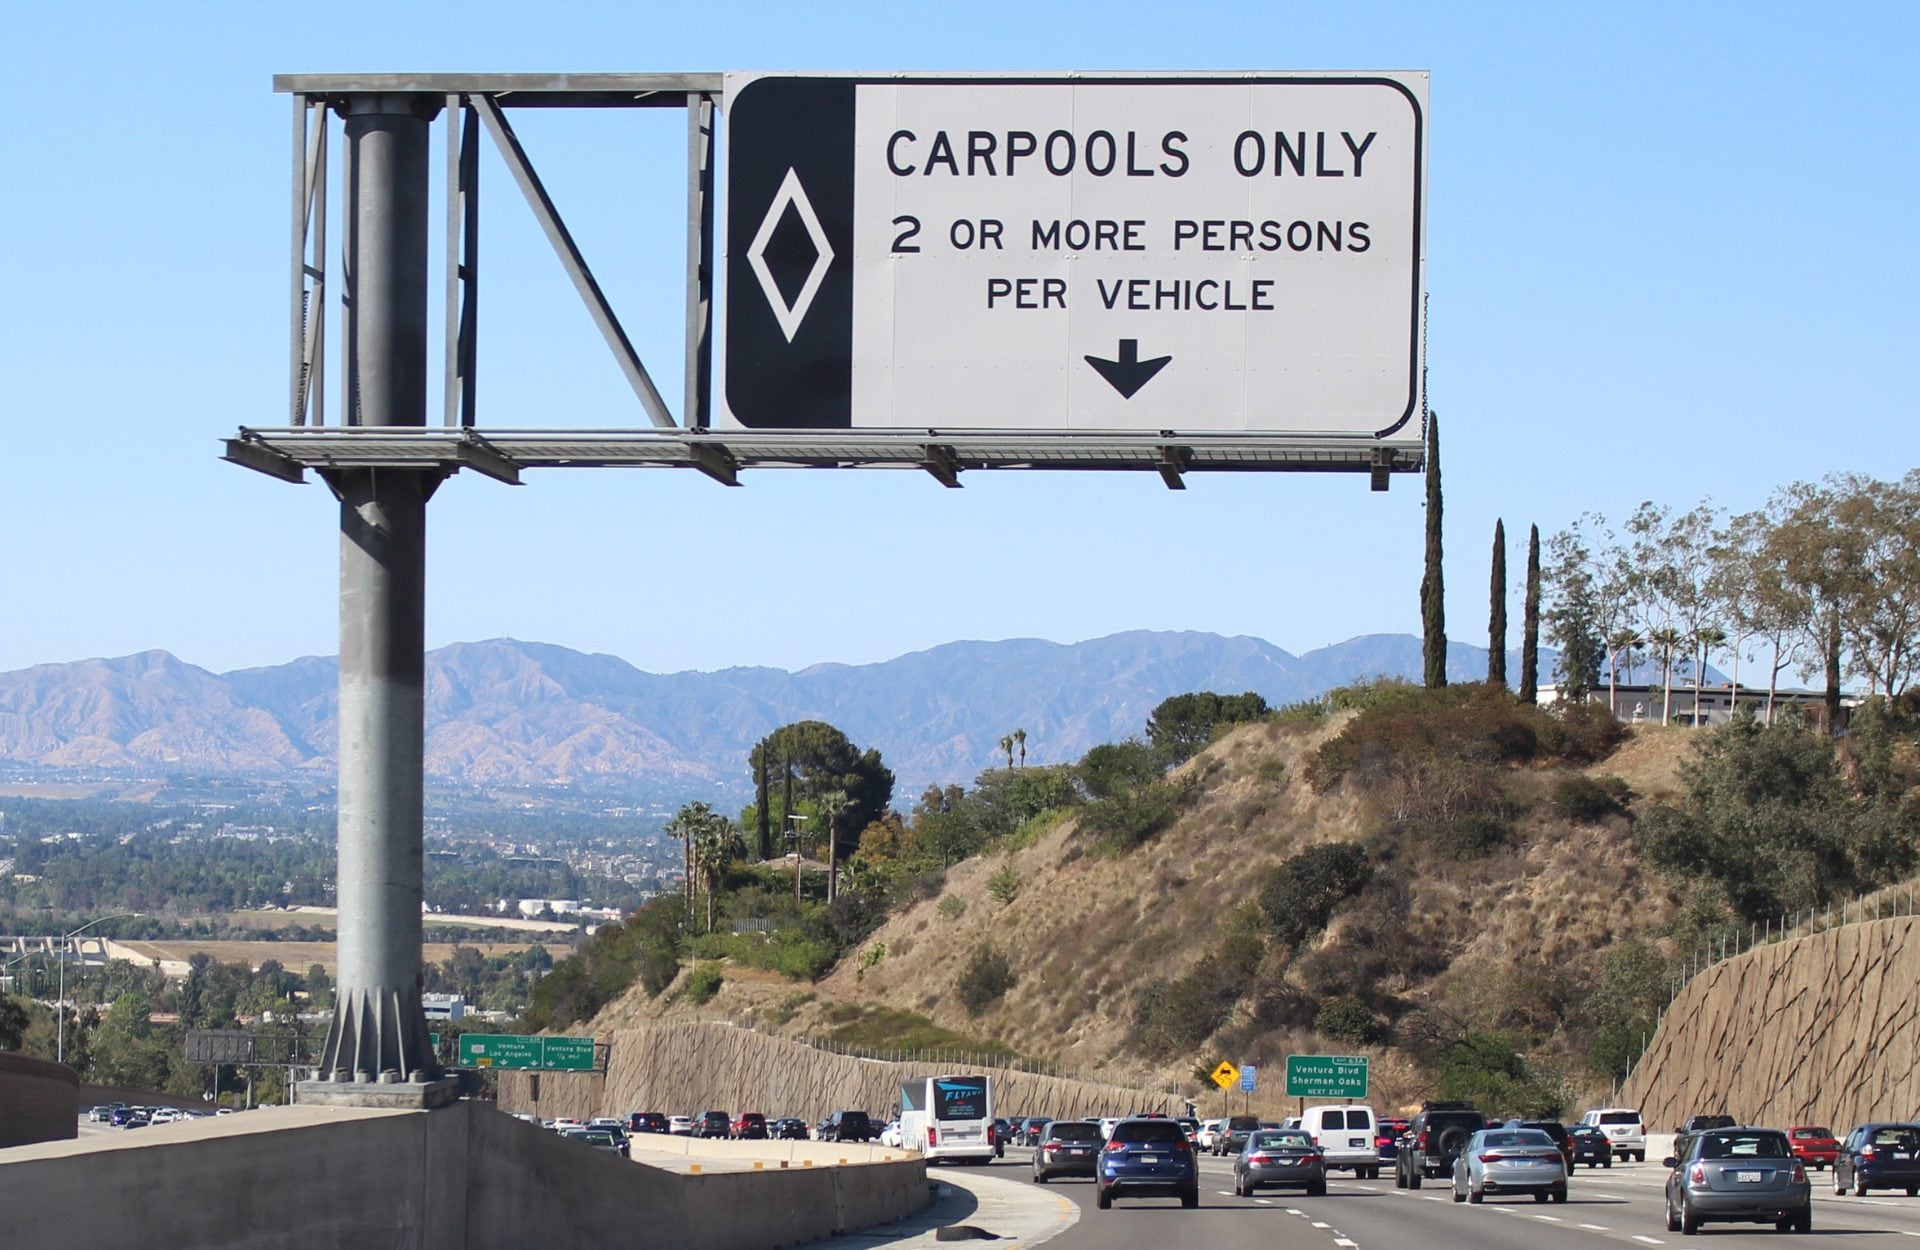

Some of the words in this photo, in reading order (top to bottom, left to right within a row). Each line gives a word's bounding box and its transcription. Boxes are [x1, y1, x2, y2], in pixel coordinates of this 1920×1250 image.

[886, 129, 1190, 178] CARPOOLS
[1233, 130, 1378, 178] ONLY
[891, 215, 921, 254] 2
[950, 218, 1004, 250] OR
[1032, 219, 1146, 251] MORE
[1174, 220, 1371, 253] PERSONS
[987, 278, 1067, 309] PER
[1096, 278, 1275, 311] VEHICLE
[1295, 1065, 1334, 1074] Ventura
[1338, 1066, 1359, 1075] Blvd
[1292, 1076, 1334, 1085] Sherman
[1338, 1077, 1361, 1086] Oaks
[1329, 1088, 1345, 1096] EXIT
